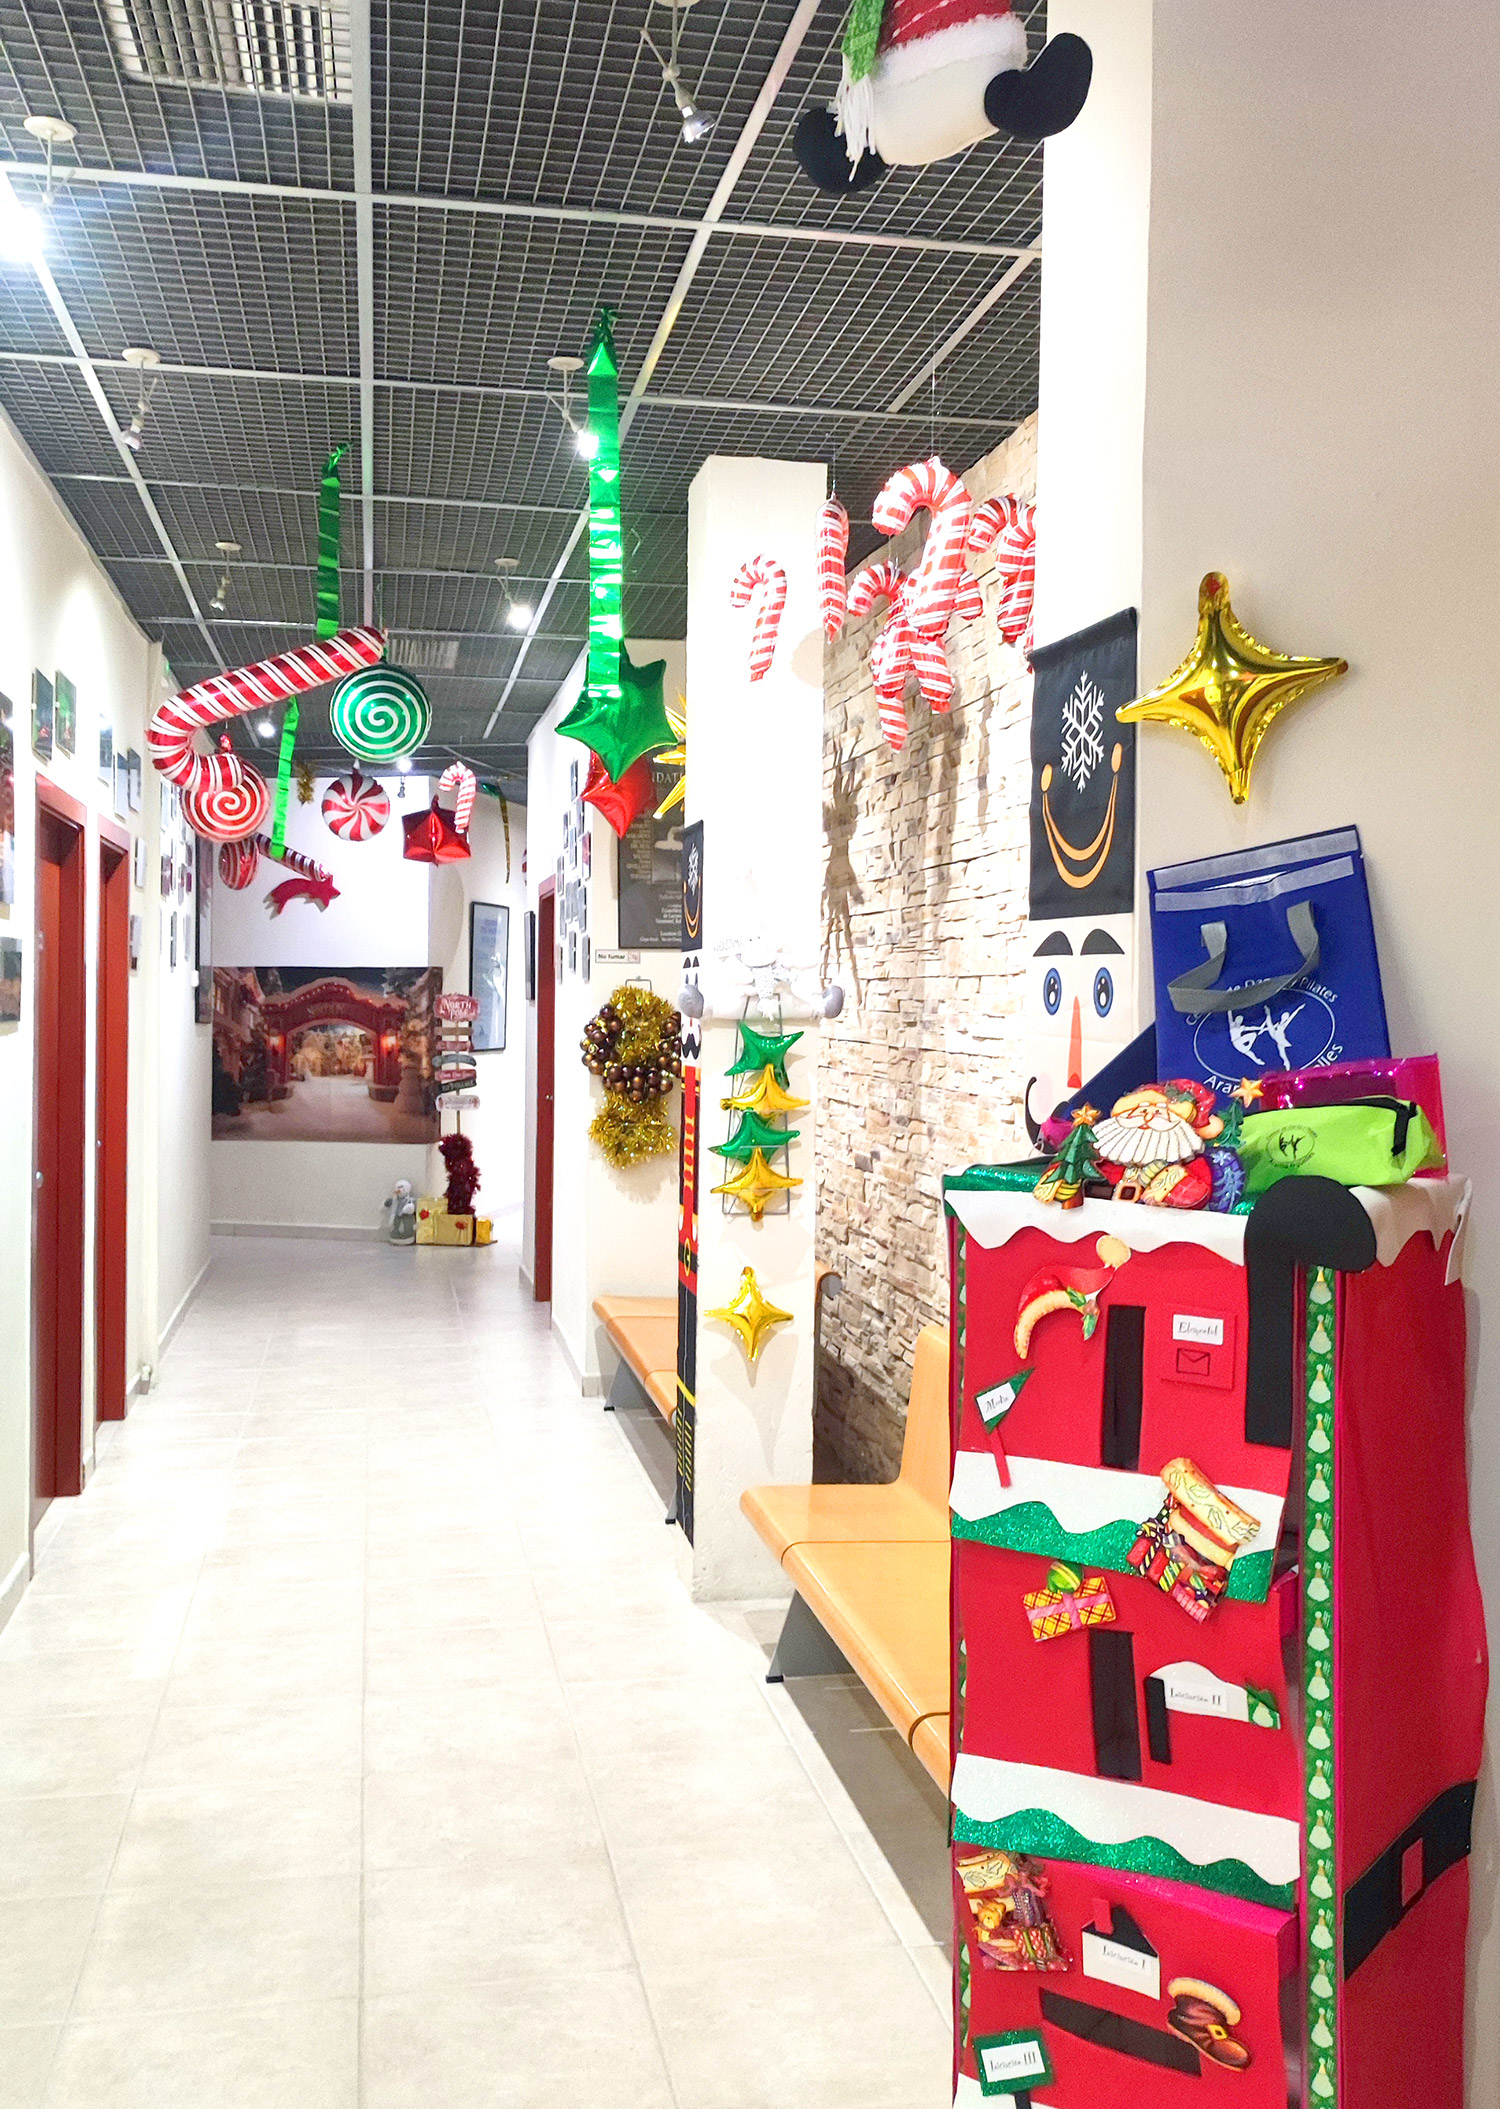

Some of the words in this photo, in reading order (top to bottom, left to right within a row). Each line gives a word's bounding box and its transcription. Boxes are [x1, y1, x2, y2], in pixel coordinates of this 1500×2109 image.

[1299, 976, 1339, 1004] Pilates
[443, 998, 472, 1012] NORTH
[1212, 1695, 1221, 1705] II
[1141, 1958, 1146, 1970] I
[1023, 2051, 1037, 2066] III
